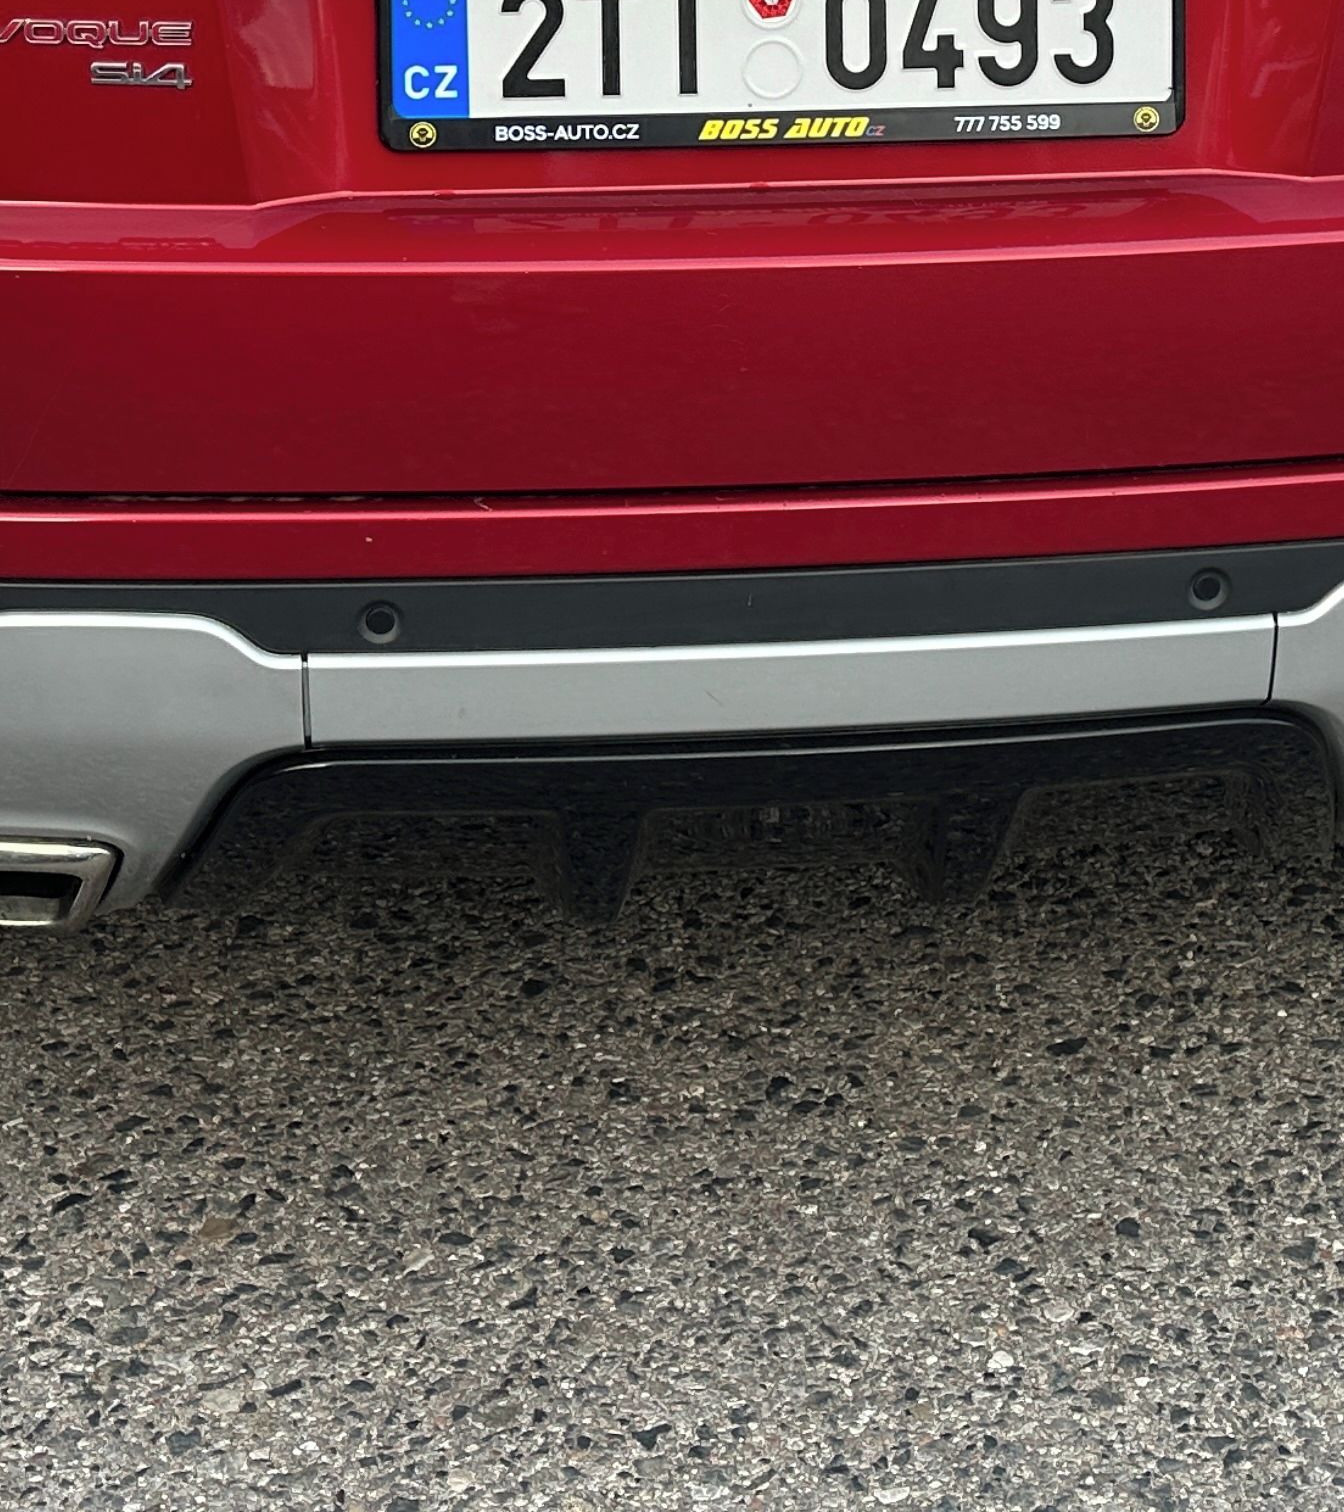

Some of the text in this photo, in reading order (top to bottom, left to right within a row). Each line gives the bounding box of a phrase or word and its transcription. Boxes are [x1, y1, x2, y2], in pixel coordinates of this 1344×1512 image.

[90, 61, 192, 89] Si4
[404, 65, 458, 100] CZ
[494, 123, 640, 142] BOSS-AUTO.CZ
[698, 118, 780, 141] BOSS
[783, 116, 870, 138] AUTO
[954, 113, 1061, 133] 777 755 599
